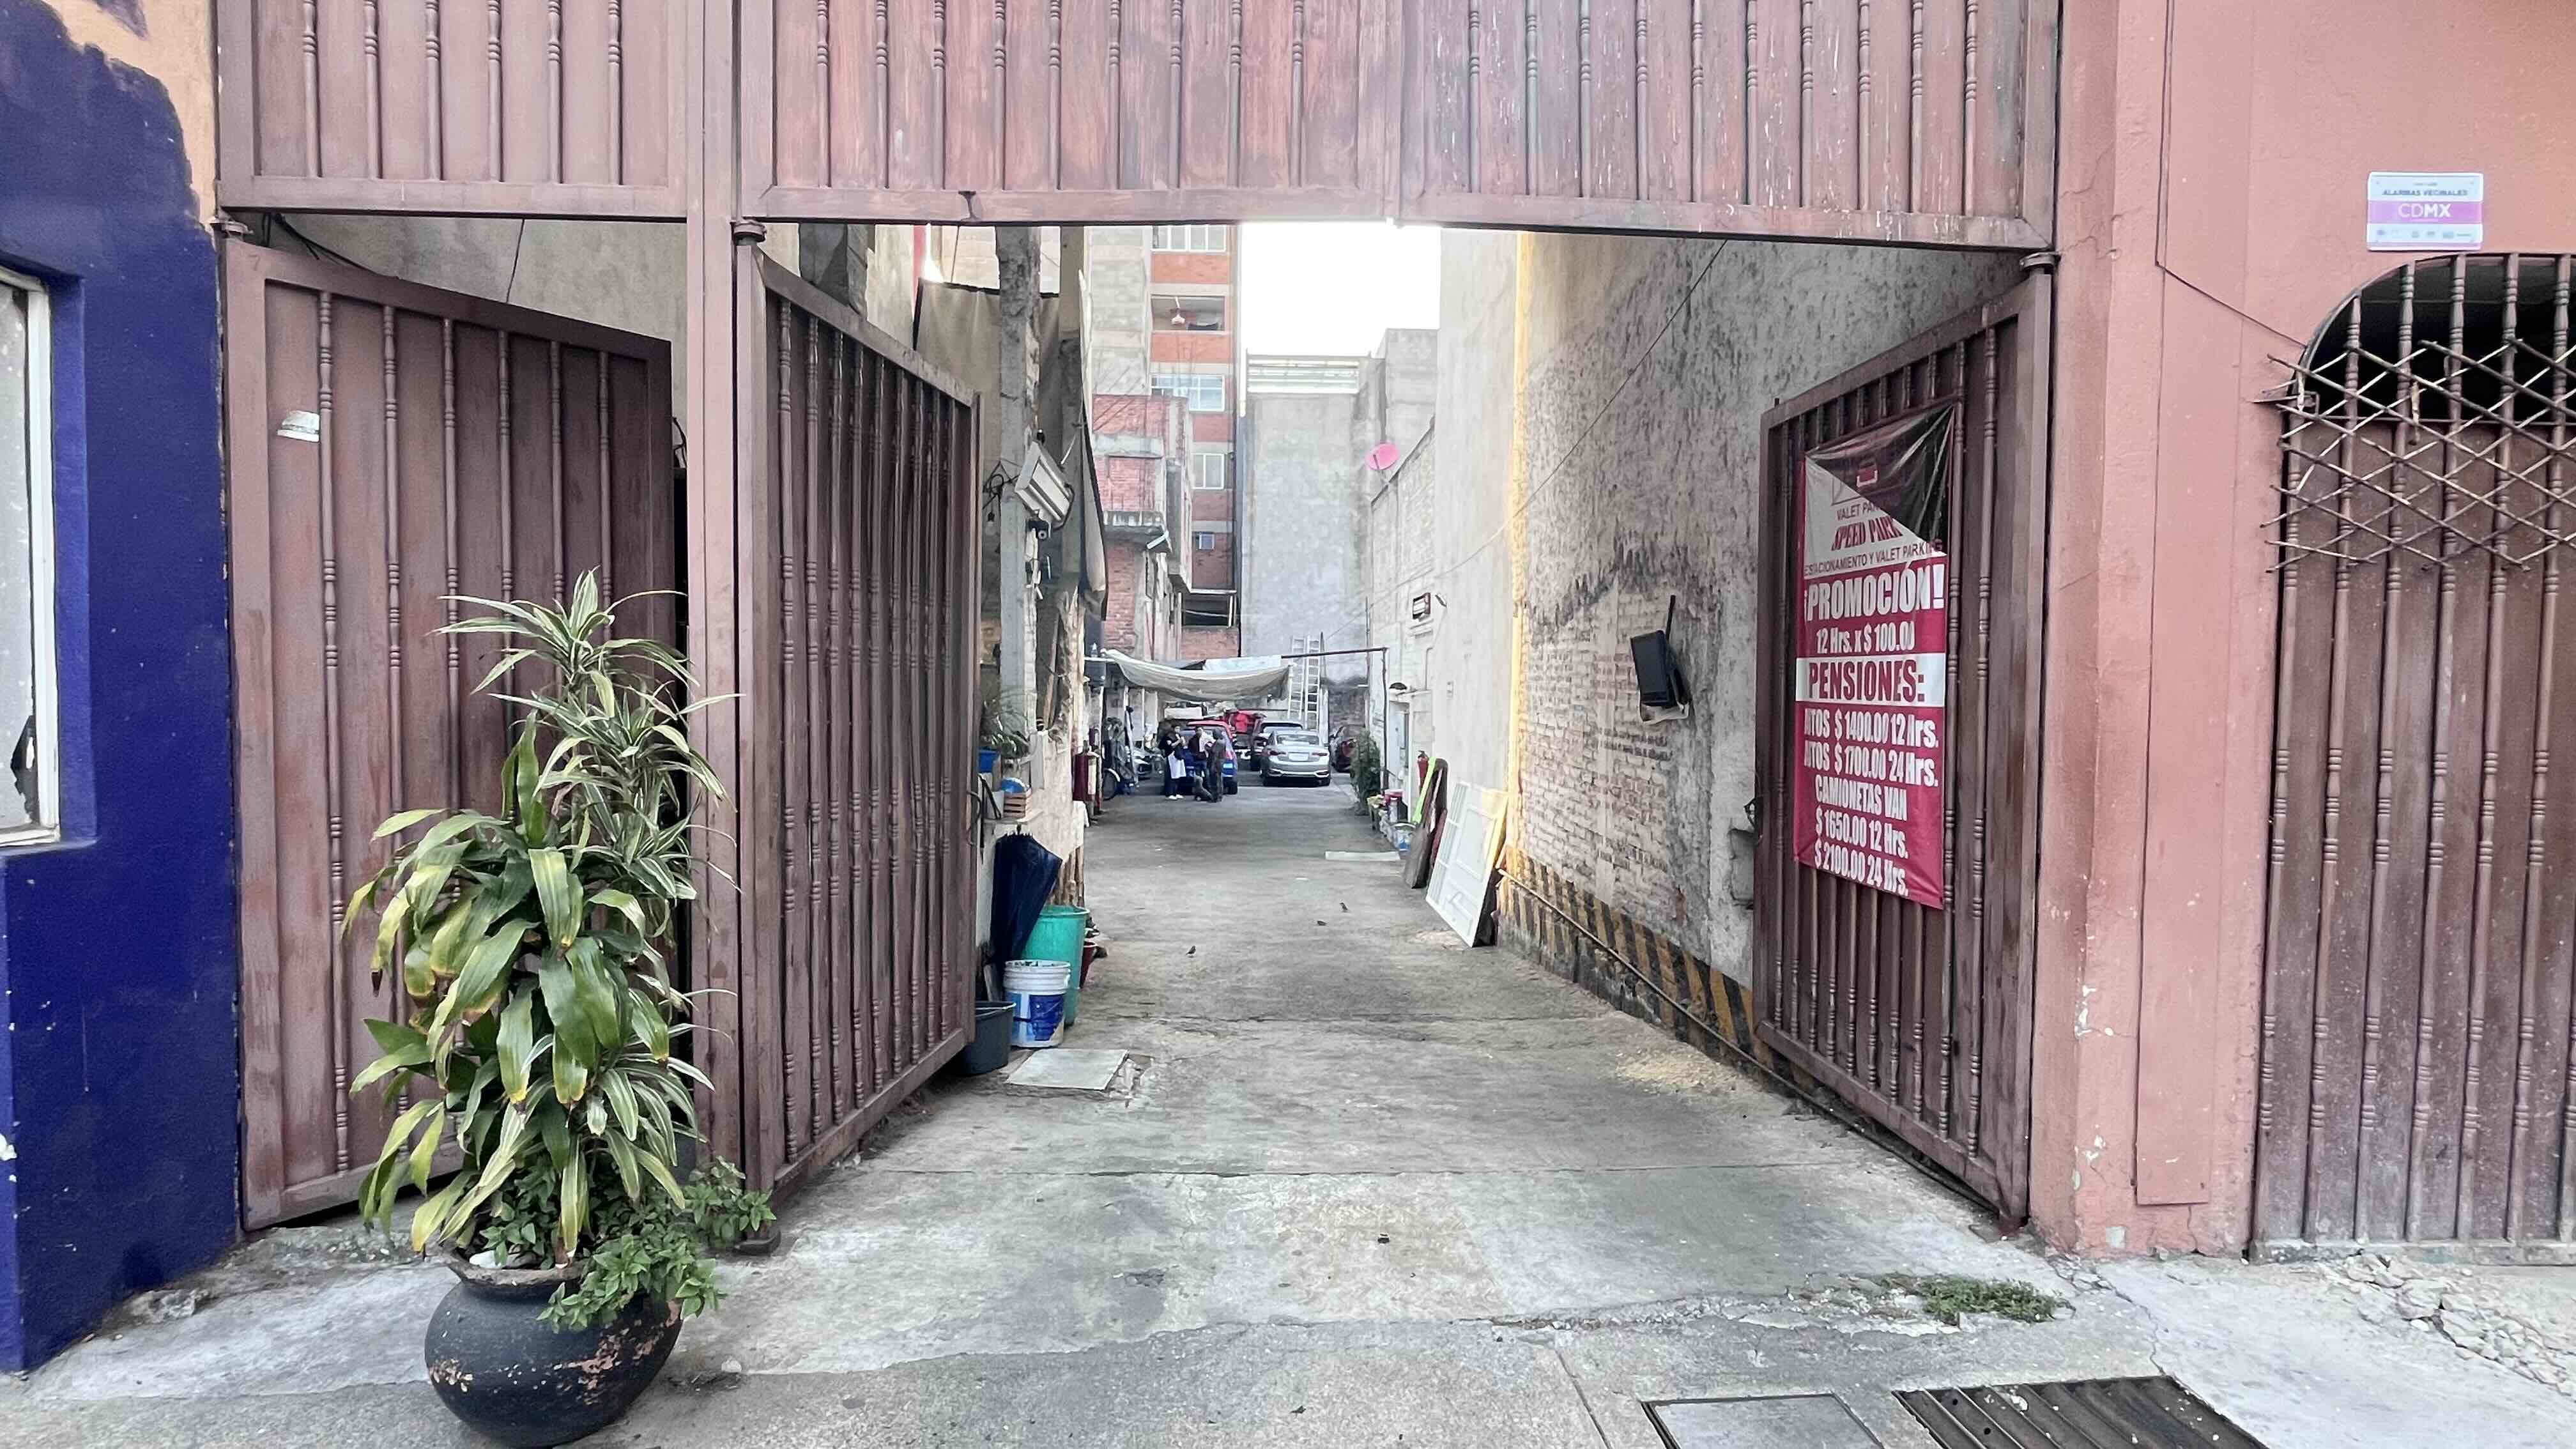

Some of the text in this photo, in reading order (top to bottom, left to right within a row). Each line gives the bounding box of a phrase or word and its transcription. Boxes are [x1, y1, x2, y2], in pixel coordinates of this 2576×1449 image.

[2398, 203, 2452, 218] CDMX
[1836, 503, 1860, 521] VALET
[1831, 522, 1866, 551] SPEED
[1869, 552, 1874, 564] Y
[1876, 547, 1901, 563] VALET
[1804, 562, 1945, 622] ¡PROMOCIÓN!
[1816, 628, 1828, 654] 12
[1809, 659, 1925, 703] PENSIONES:
[1890, 713, 1906, 746] 12
[1889, 749, 1905, 783] 24
[1905, 752, 1939, 787] Hrs.
[1815, 774, 1907, 821] CAMIONETAS VAN
[1869, 820, 1882, 852] 12
[1884, 822, 1908, 859] Hrs.
[1867, 854, 1882, 887] 24
[1883, 859, 1908, 896] Hrs.
